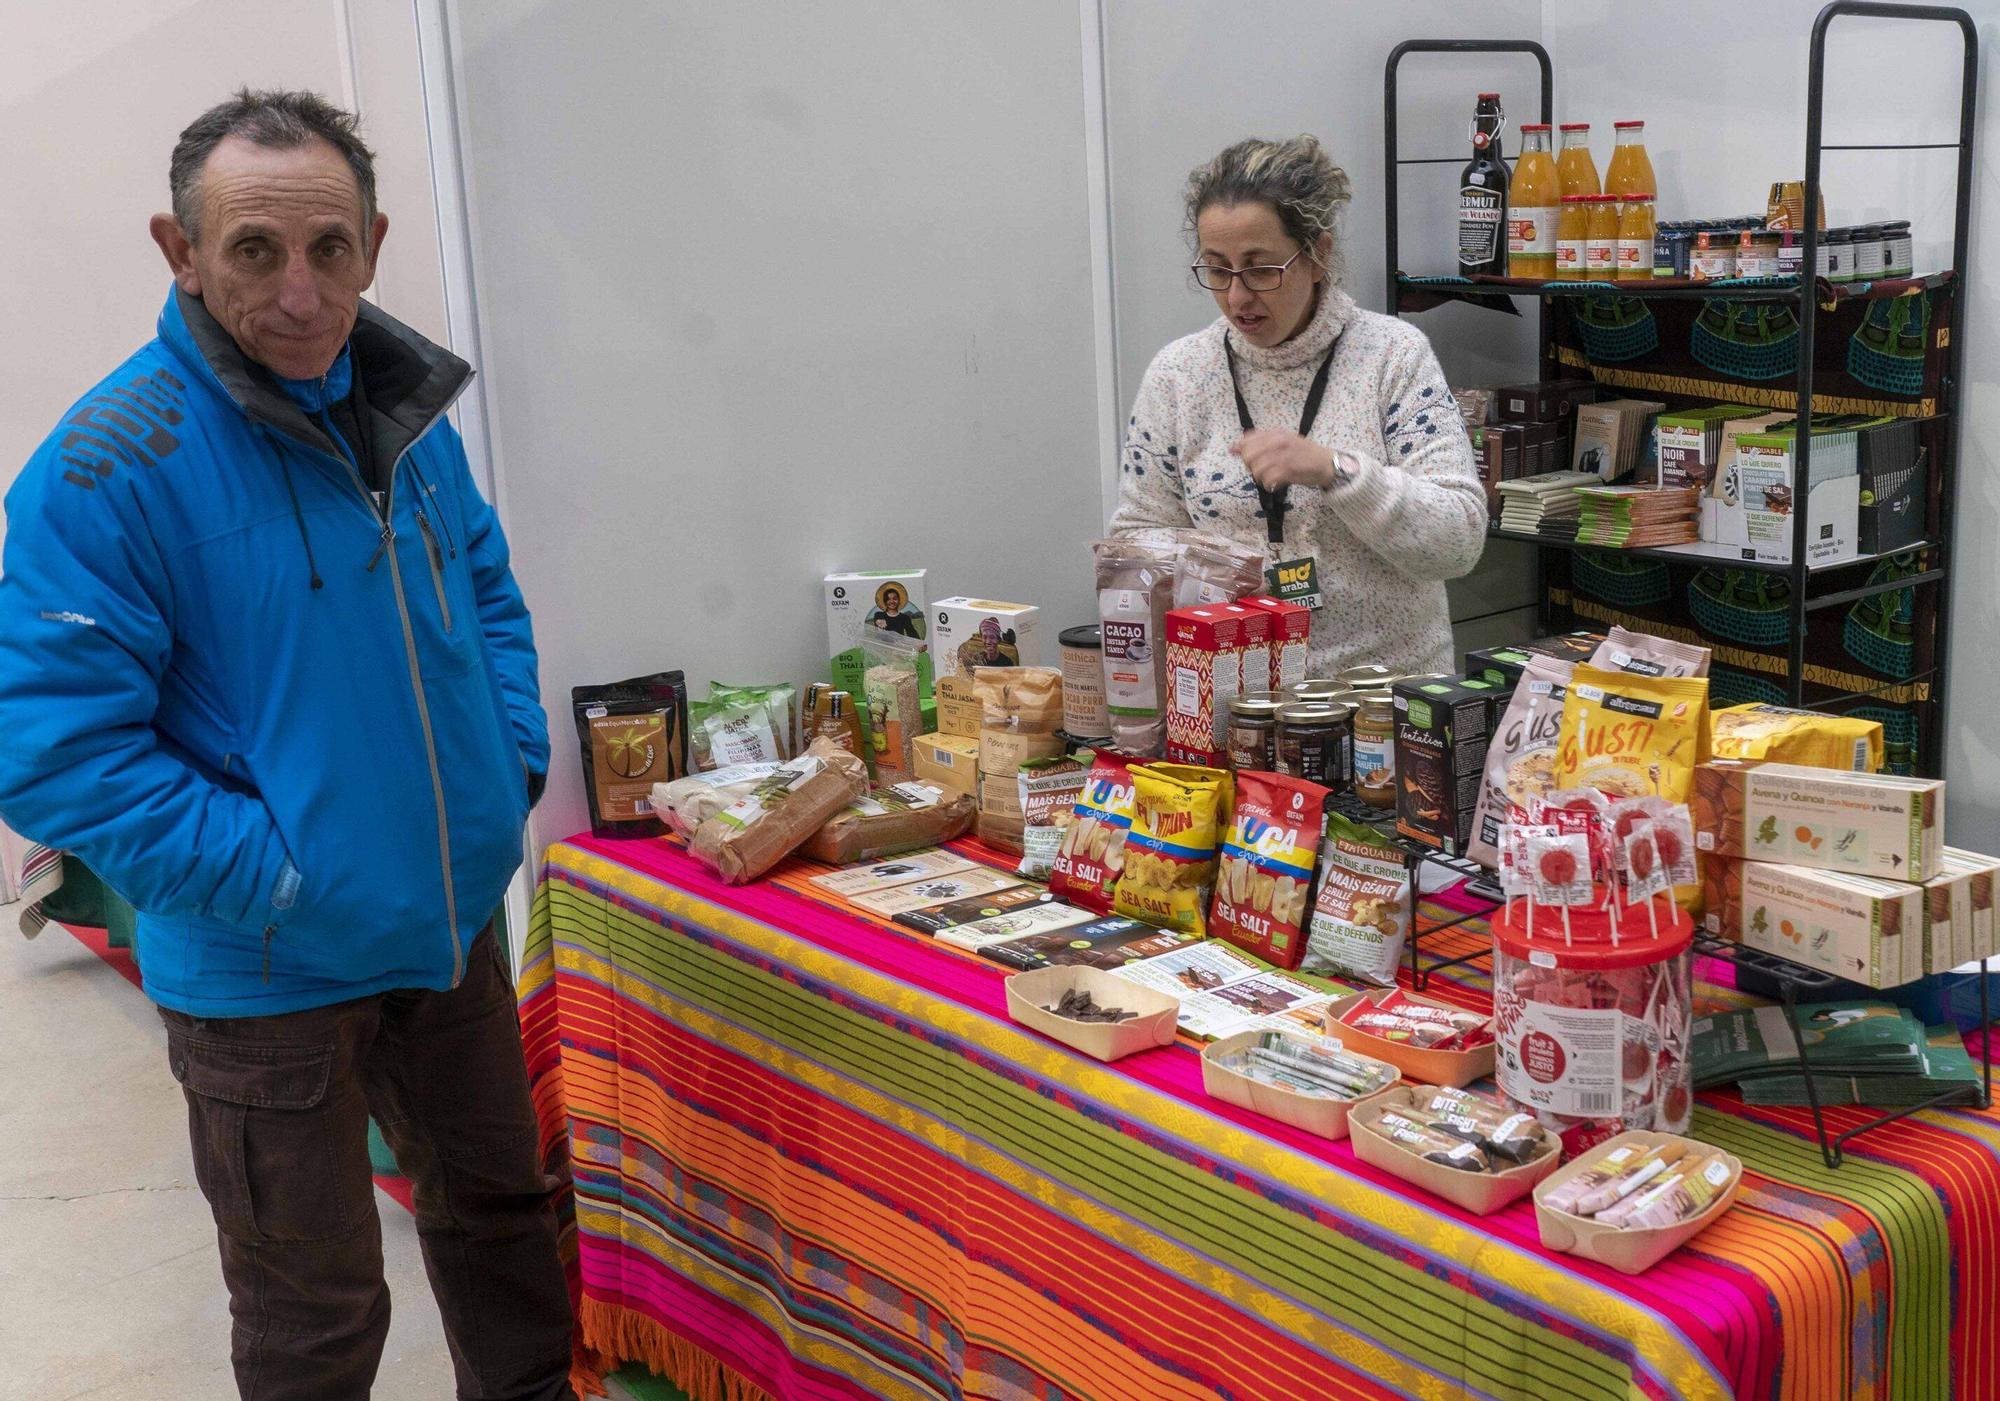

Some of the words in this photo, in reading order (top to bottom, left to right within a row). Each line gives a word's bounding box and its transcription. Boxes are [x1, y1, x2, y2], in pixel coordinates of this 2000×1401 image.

[1460, 196, 1496, 208] ERMUT
[1654, 247, 1670, 256] IÑA
[1663, 448, 1685, 460] NOIR
[1663, 468, 1687, 477] AMANDE
[1744, 476, 1777, 485] CARAMELO
[1773, 487, 1785, 495] SAL
[1279, 562, 1311, 585] BIO
[1280, 580, 1309, 593] araba
[936, 626, 952, 634] OXFAM
[1105, 625, 1142, 637] CACAO
[1106, 637, 1128, 646] INSTAN-
[840, 662, 859, 670] THAI
[941, 683, 953, 692] BIO
[941, 692, 957, 701] THAI
[958, 693, 976, 703] JASM
[723, 718, 749, 730] ALTER
[1354, 733, 1383, 743] QUABLE
[1399, 723, 1443, 748] Tentation
[727, 743, 761, 756] FILIPINAS
[1036, 780, 1052, 790] QUE
[1052, 779, 1061, 789] JE
[1061, 775, 1088, 787] CROQUE
[1751, 774, 1802, 790] Galletas
[1803, 779, 1866, 798] integrales
[1870, 787, 1887, 800] de
[1028, 793, 1056, 809] MAÏS
[1056, 790, 1079, 806] GÉA
[1082, 776, 1136, 813] YUCA
[1751, 787, 1782, 800] Avena
[1782, 792, 1789, 801] y
[1790, 791, 1825, 805] Quinoa
[1086, 809, 1113, 822] chips
[1237, 802, 1273, 818] organic
[1286, 810, 1305, 822] OXFAM
[1235, 814, 1298, 857] YUCA
[1237, 848, 1267, 868] chips
[1337, 839, 1405, 862] ETHIQUABLE
[1053, 857, 1073, 875] SEA
[1076, 863, 1103, 884] SALT
[1332, 853, 1342, 863] CE
[1343, 857, 1360, 871] QUE
[1360, 863, 1372, 874] JE
[1372, 864, 1409, 881] CROQUE
[1328, 870, 1361, 892] MAÏS
[1360, 879, 1397, 898] GÉANT
[1747, 876, 1771, 892] Avena
[1770, 883, 1777, 895] y
[1776, 884, 1805, 900] Quinoa
[1324, 885, 1354, 901] GRILLÉ
[1120, 889, 1141, 907] SEA
[1144, 897, 1172, 917] SALT
[1318, 894, 1331, 903] ET
[1330, 897, 1353, 912] SALÉ
[1217, 901, 1237, 924] SEA
[1240, 911, 1271, 937] SALT
[1319, 920, 1335, 932] QUE
[1334, 924, 1343, 936] JE
[1245, 978, 1280, 996] NOIR
[1528, 1059, 1555, 1072] JUSTO
[1442, 1086, 1469, 1101] BITE
[1430, 1095, 1457, 1112] BITE
[1456, 1102, 1471, 1114] TO
[1381, 1113, 1410, 1129] BITE
[1447, 1113, 1479, 1132] FIGHT
[1392, 1127, 1429, 1144] FIGHT
